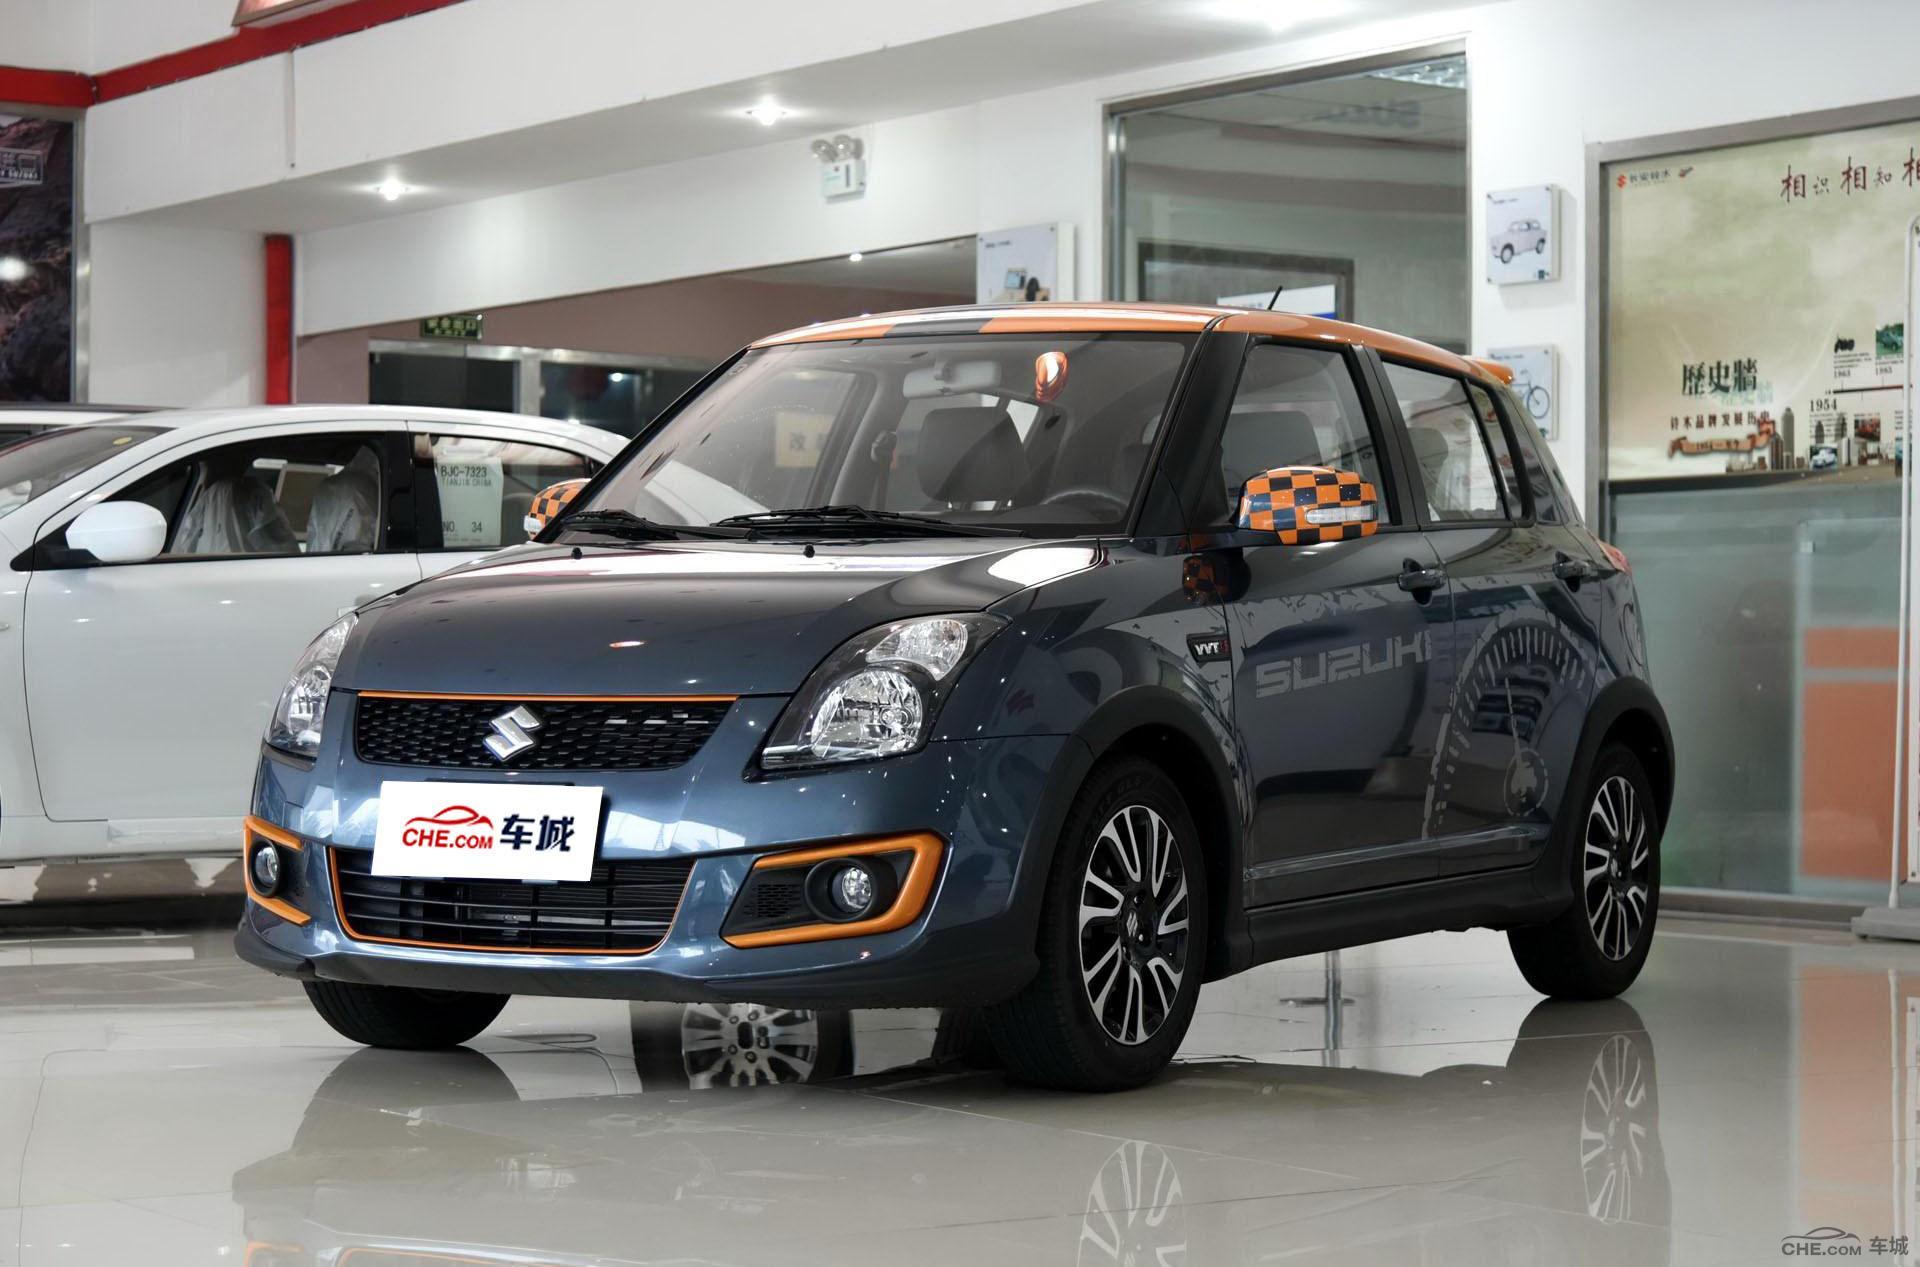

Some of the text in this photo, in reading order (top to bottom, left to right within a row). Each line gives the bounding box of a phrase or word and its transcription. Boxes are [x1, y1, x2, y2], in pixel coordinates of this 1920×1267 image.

[1810, 398, 1837, 412] 1954
[440, 465, 487, 478] BJC-7323
[441, 478, 470, 487] TIANJIN
[471, 521, 482, 533] 34
[1256, 629, 1432, 698] SUZUKI
[402, 814, 575, 852] CHE.COM 车城
